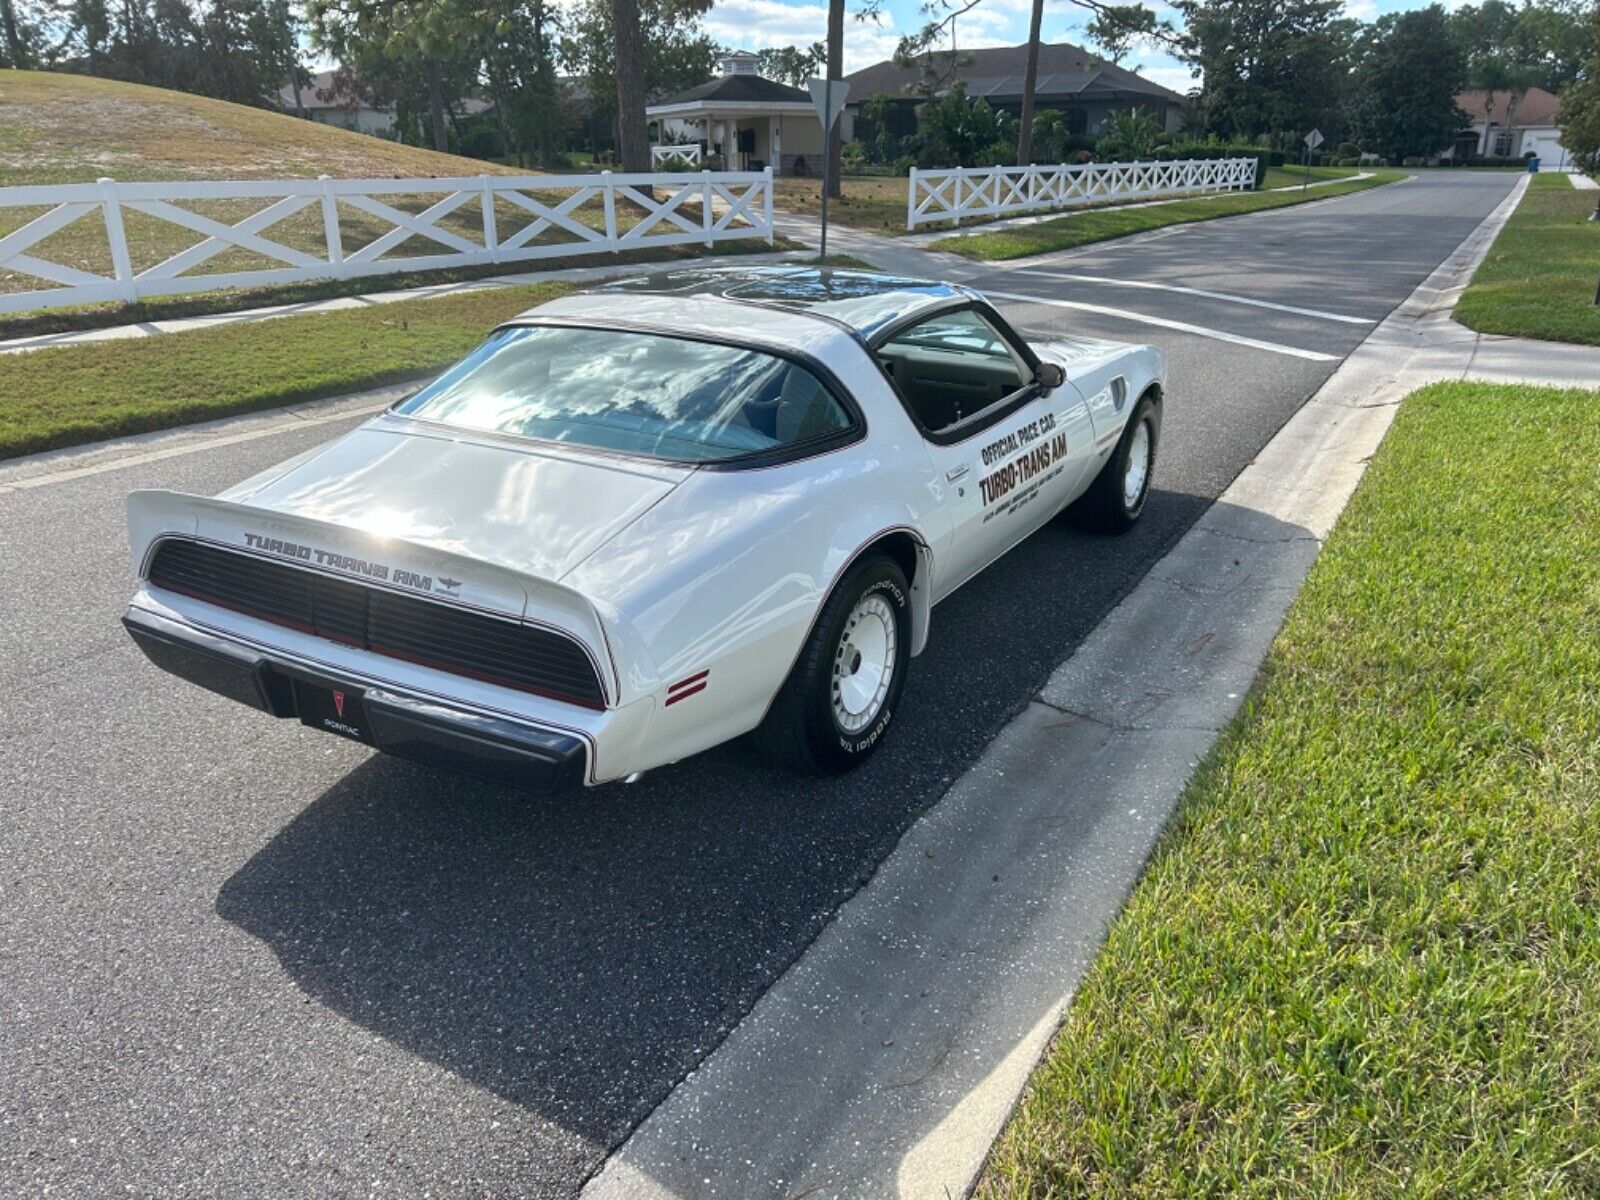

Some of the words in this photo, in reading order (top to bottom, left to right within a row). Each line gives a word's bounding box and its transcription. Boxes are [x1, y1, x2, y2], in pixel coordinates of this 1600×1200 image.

[981, 433, 1019, 466] OFFICIAL
[1017, 422, 1038, 446] PACE
[1039, 413, 1056, 434] CAR
[1052, 433, 1068, 465] AM
[244, 533, 312, 561] TURBO
[314, 549, 389, 580] TRANS
[393, 568, 432, 591] AM
[324, 718, 360, 736] PONTIAC
[856, 709, 891, 753] Radial
